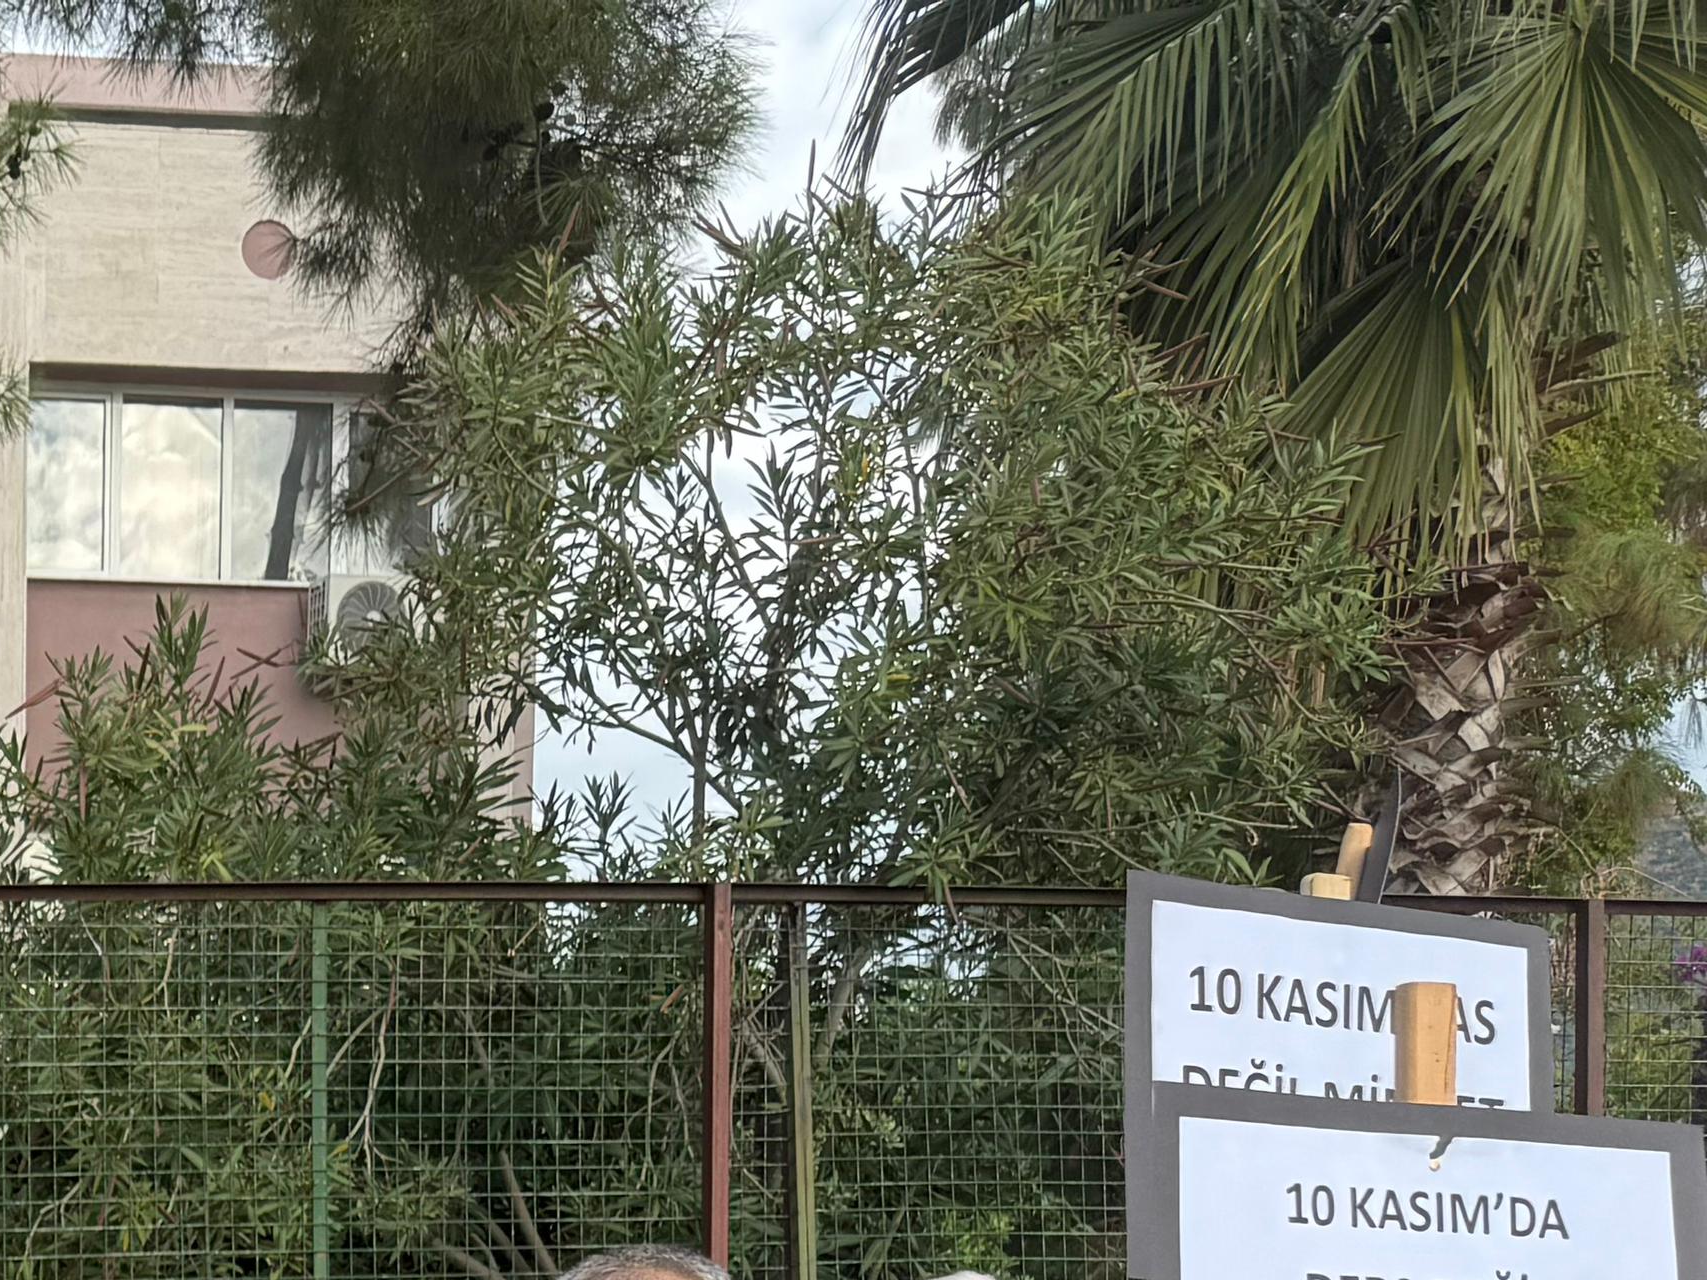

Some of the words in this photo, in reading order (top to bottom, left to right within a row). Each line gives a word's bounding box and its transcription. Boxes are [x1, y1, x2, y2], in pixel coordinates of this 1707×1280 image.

[1189, 965, 1242, 1015] 10
[1257, 973, 1397, 1036] KASIM
[1286, 1183, 1335, 1227] 10
[1350, 1187, 1570, 1240] KASIM'DA
